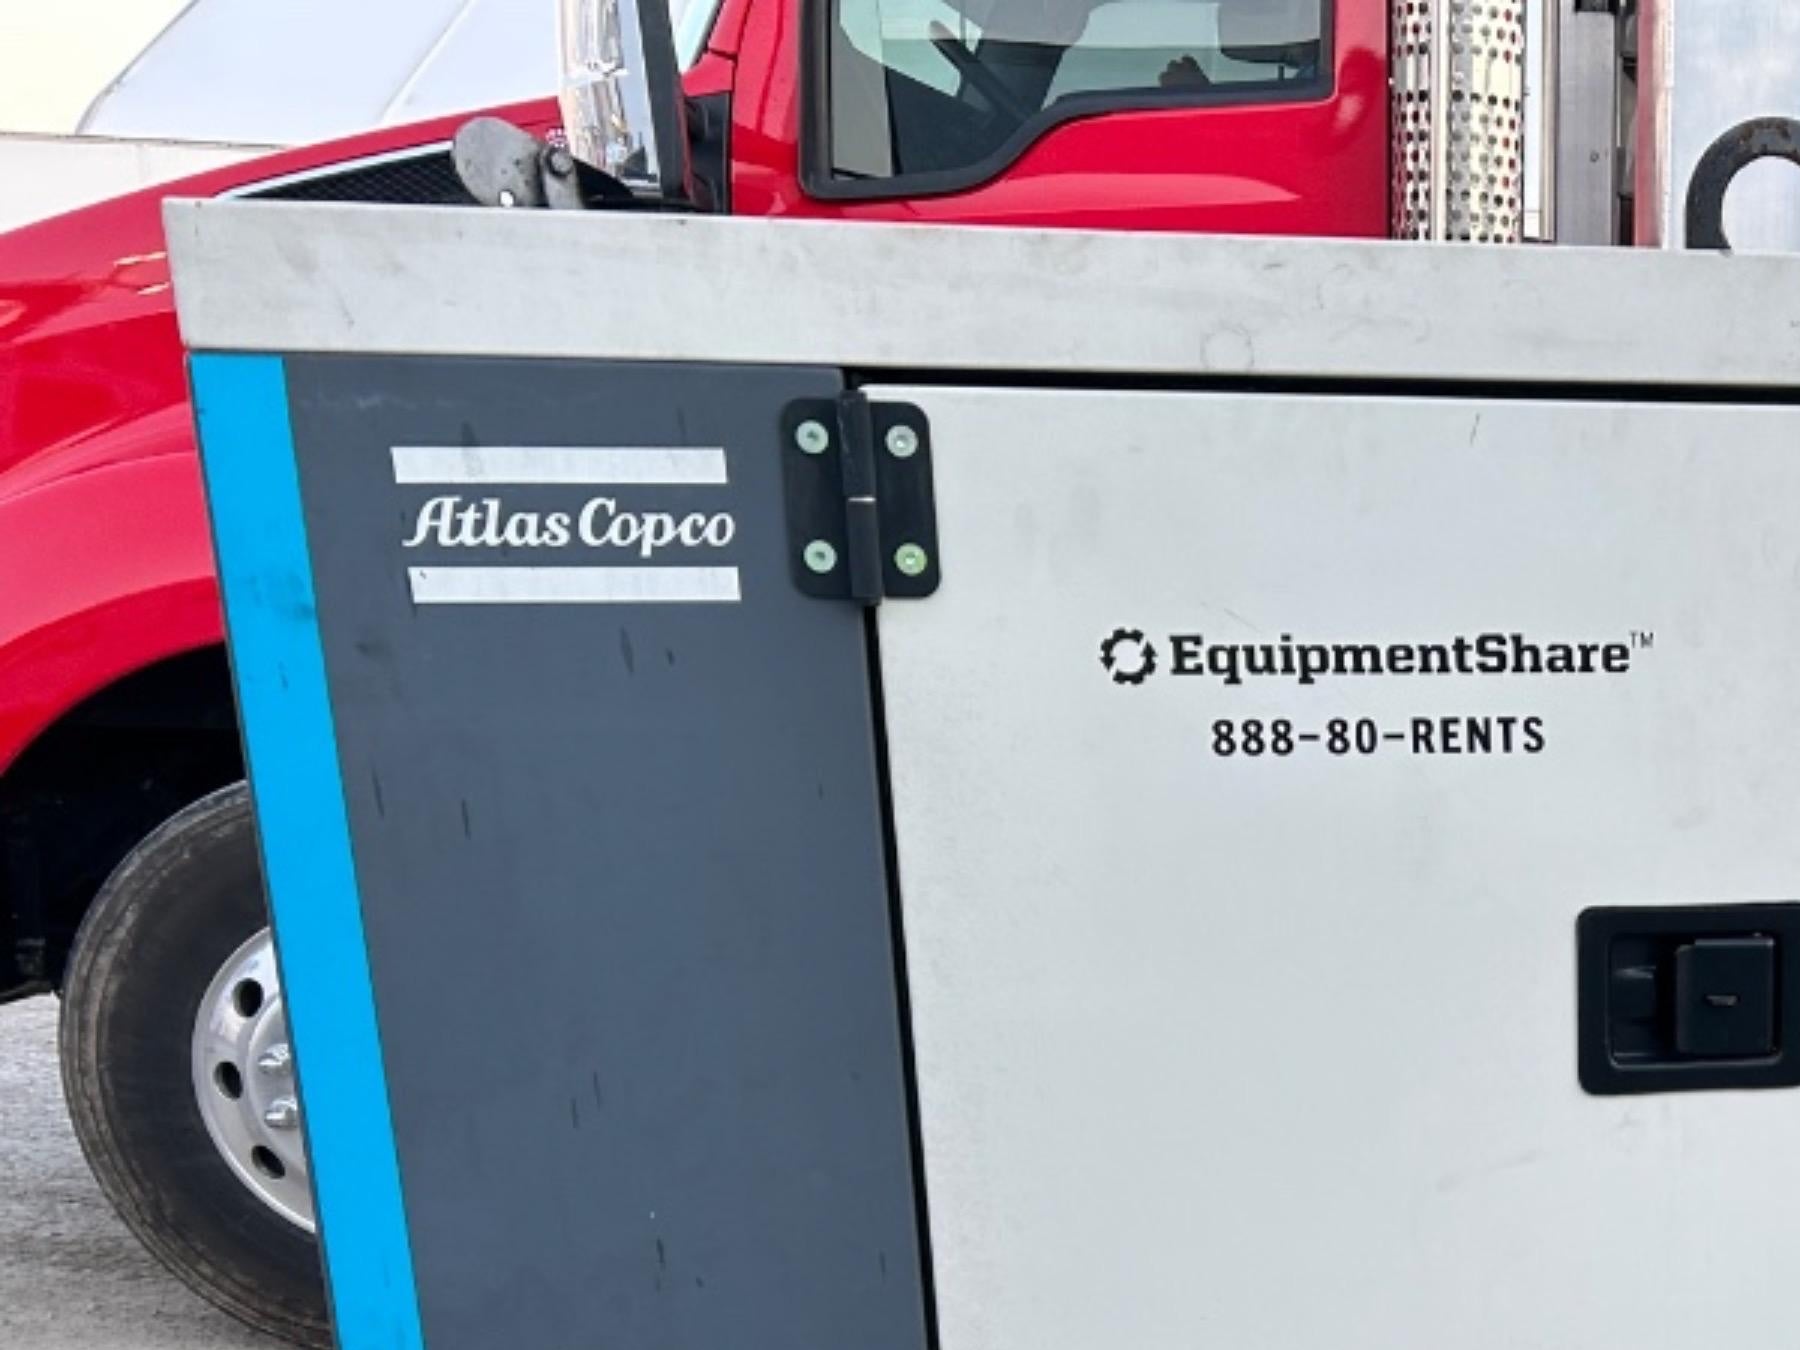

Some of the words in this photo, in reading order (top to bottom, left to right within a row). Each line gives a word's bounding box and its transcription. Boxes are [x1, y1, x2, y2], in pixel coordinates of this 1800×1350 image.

[402, 496, 571, 548] Atlas
[578, 497, 736, 558] Copco
[1211, 716, 1547, 757] 888-80-RENTS
